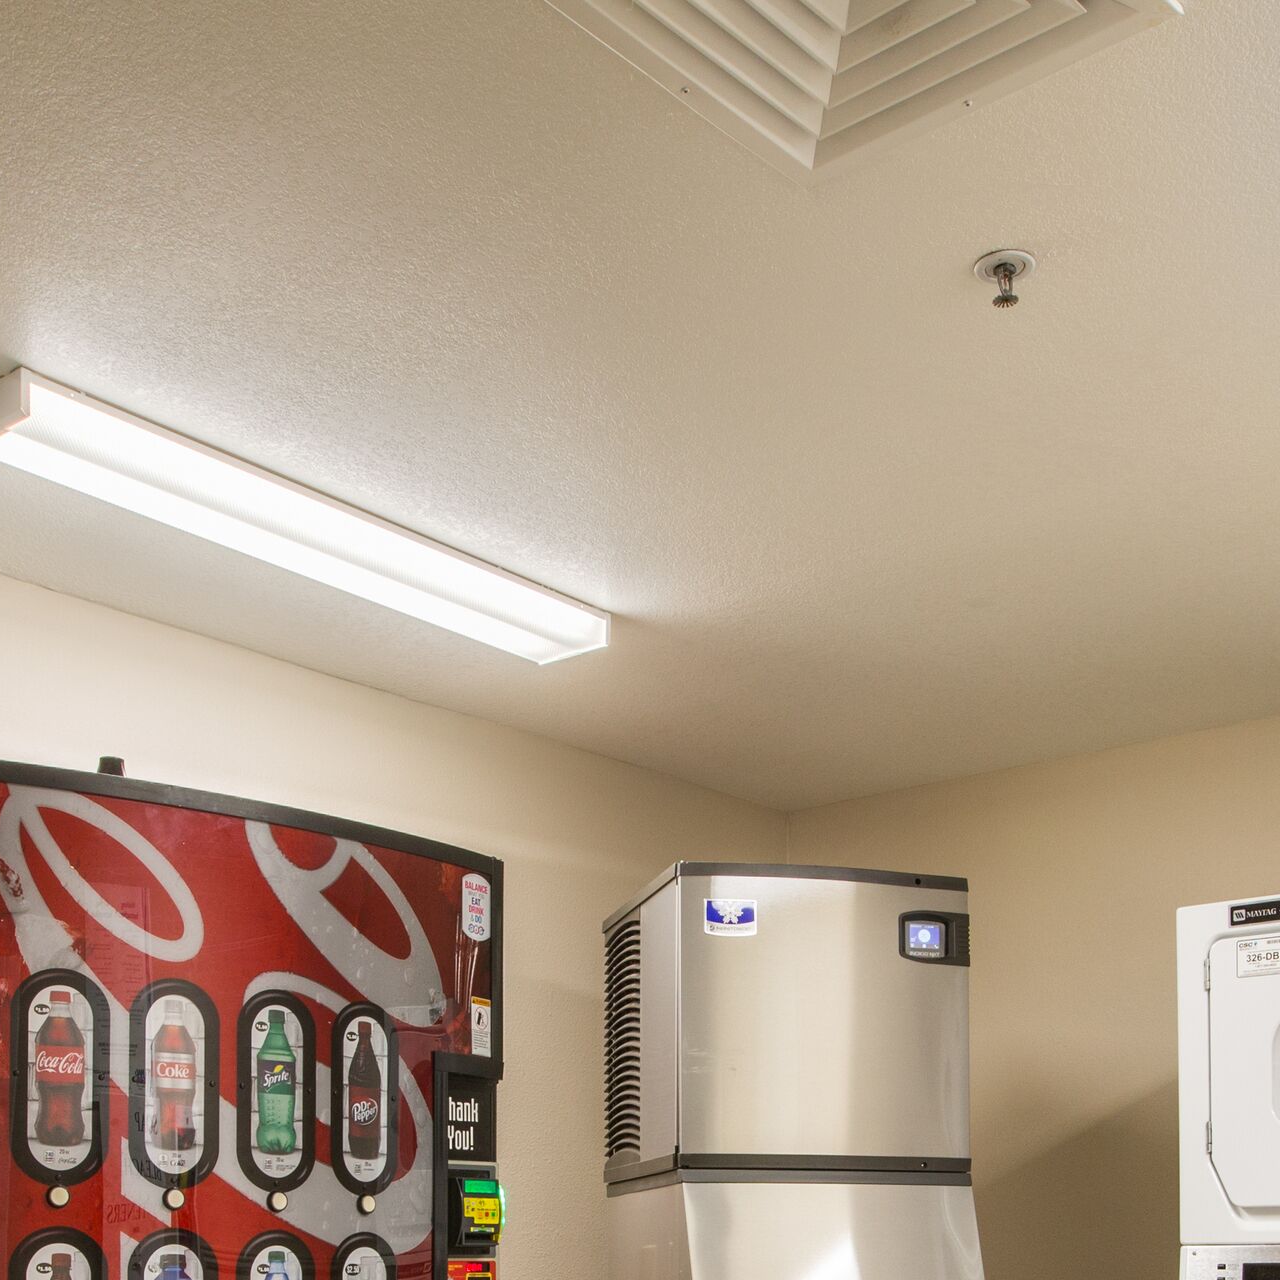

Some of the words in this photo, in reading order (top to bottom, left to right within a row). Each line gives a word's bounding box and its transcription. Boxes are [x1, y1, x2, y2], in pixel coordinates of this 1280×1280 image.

[464, 880, 488, 894] BALANCE
[472, 896, 481, 906] EAT
[1247, 907, 1277, 918] MAYTAG
[1238, 942, 1253, 950] CSC
[36, 1050, 84, 1076] Coca-Cola
[156, 1062, 190, 1079] Coke
[263, 1070, 290, 1088] Sprite
[447, 1124, 474, 1151] You!
